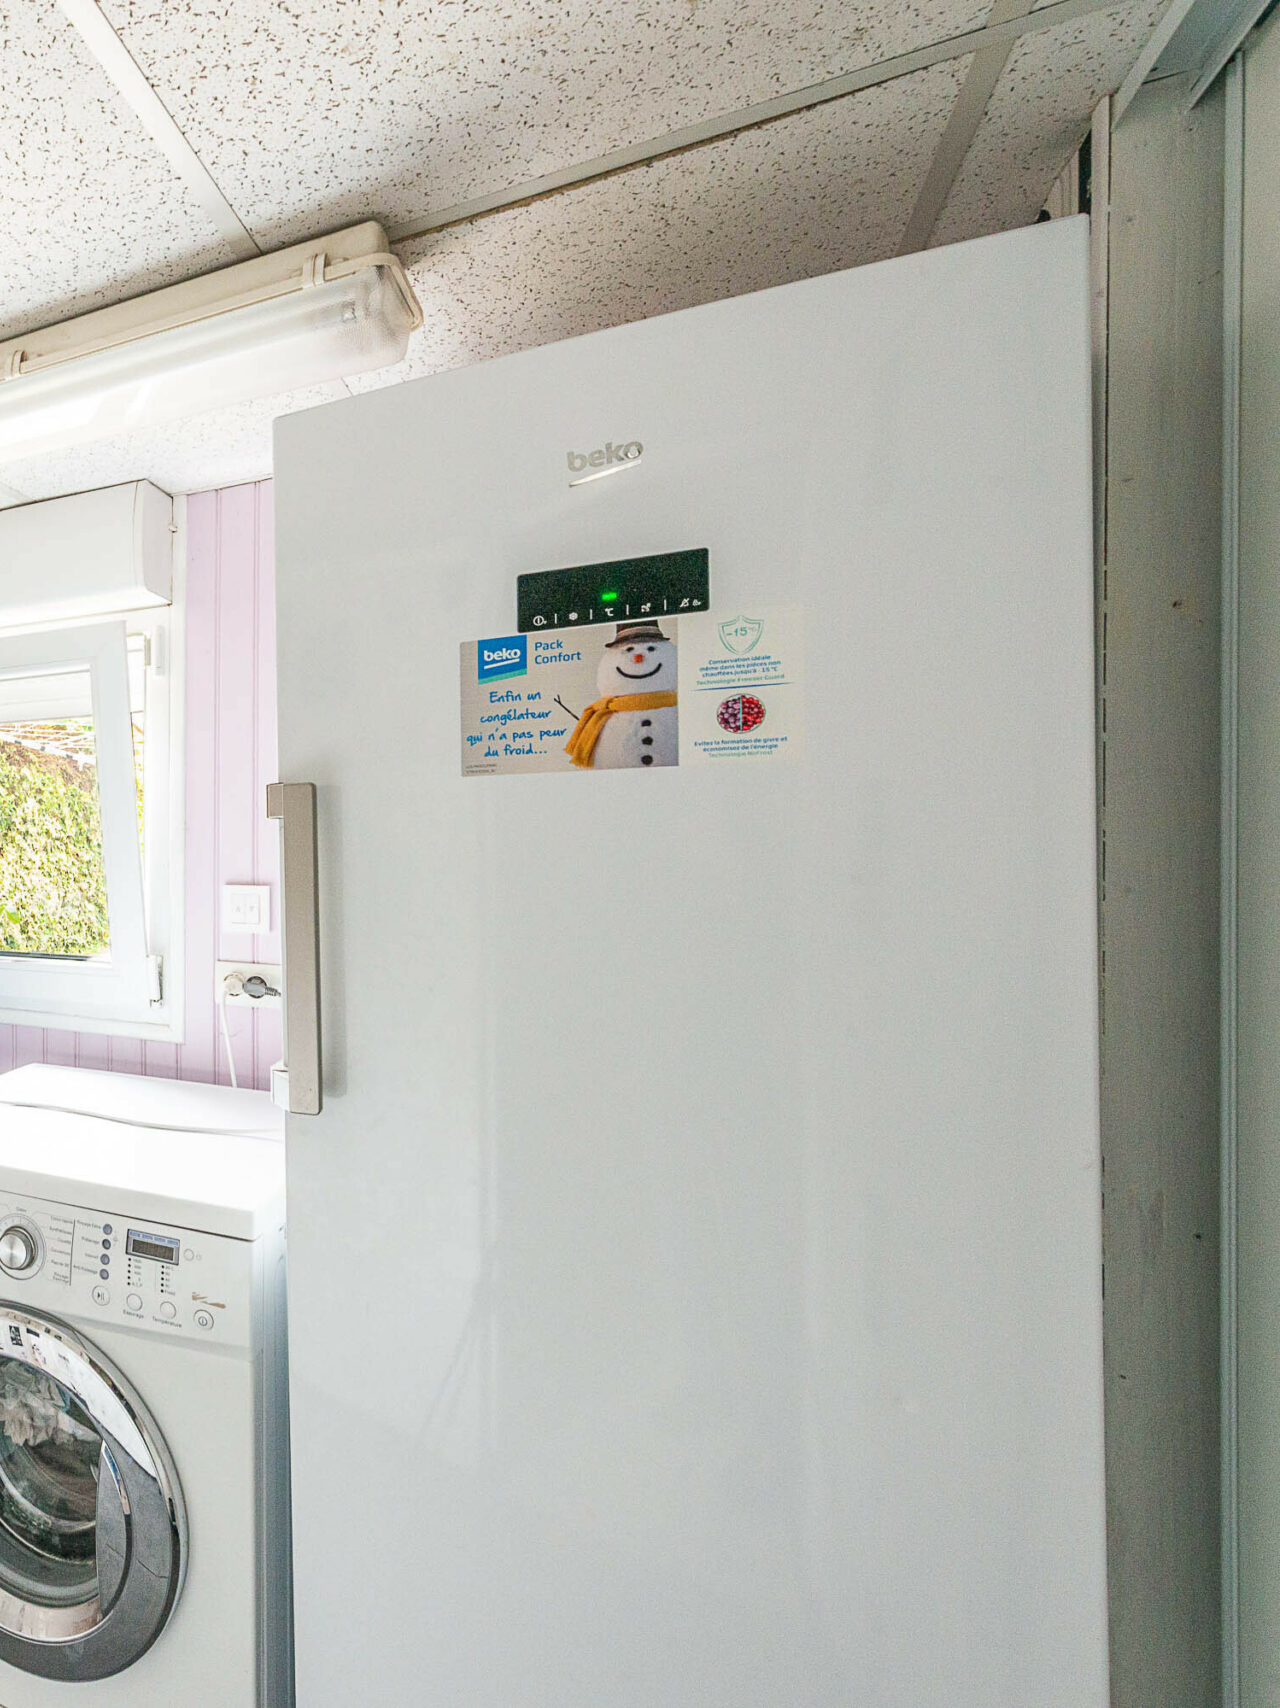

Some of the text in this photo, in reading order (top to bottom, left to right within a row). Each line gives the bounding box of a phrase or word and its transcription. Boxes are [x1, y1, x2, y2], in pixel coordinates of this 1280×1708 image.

[566, 441, 644, 473] beko
[534, 639, 563, 652] Pack
[483, 648, 521, 662] beko
[534, 651, 582, 665] Confort
[489, 690, 542, 704] Enfin un
[480, 708, 552, 726] congélateur
[466, 727, 568, 746] qui n'a pas peur
[484, 746, 499, 758] du
